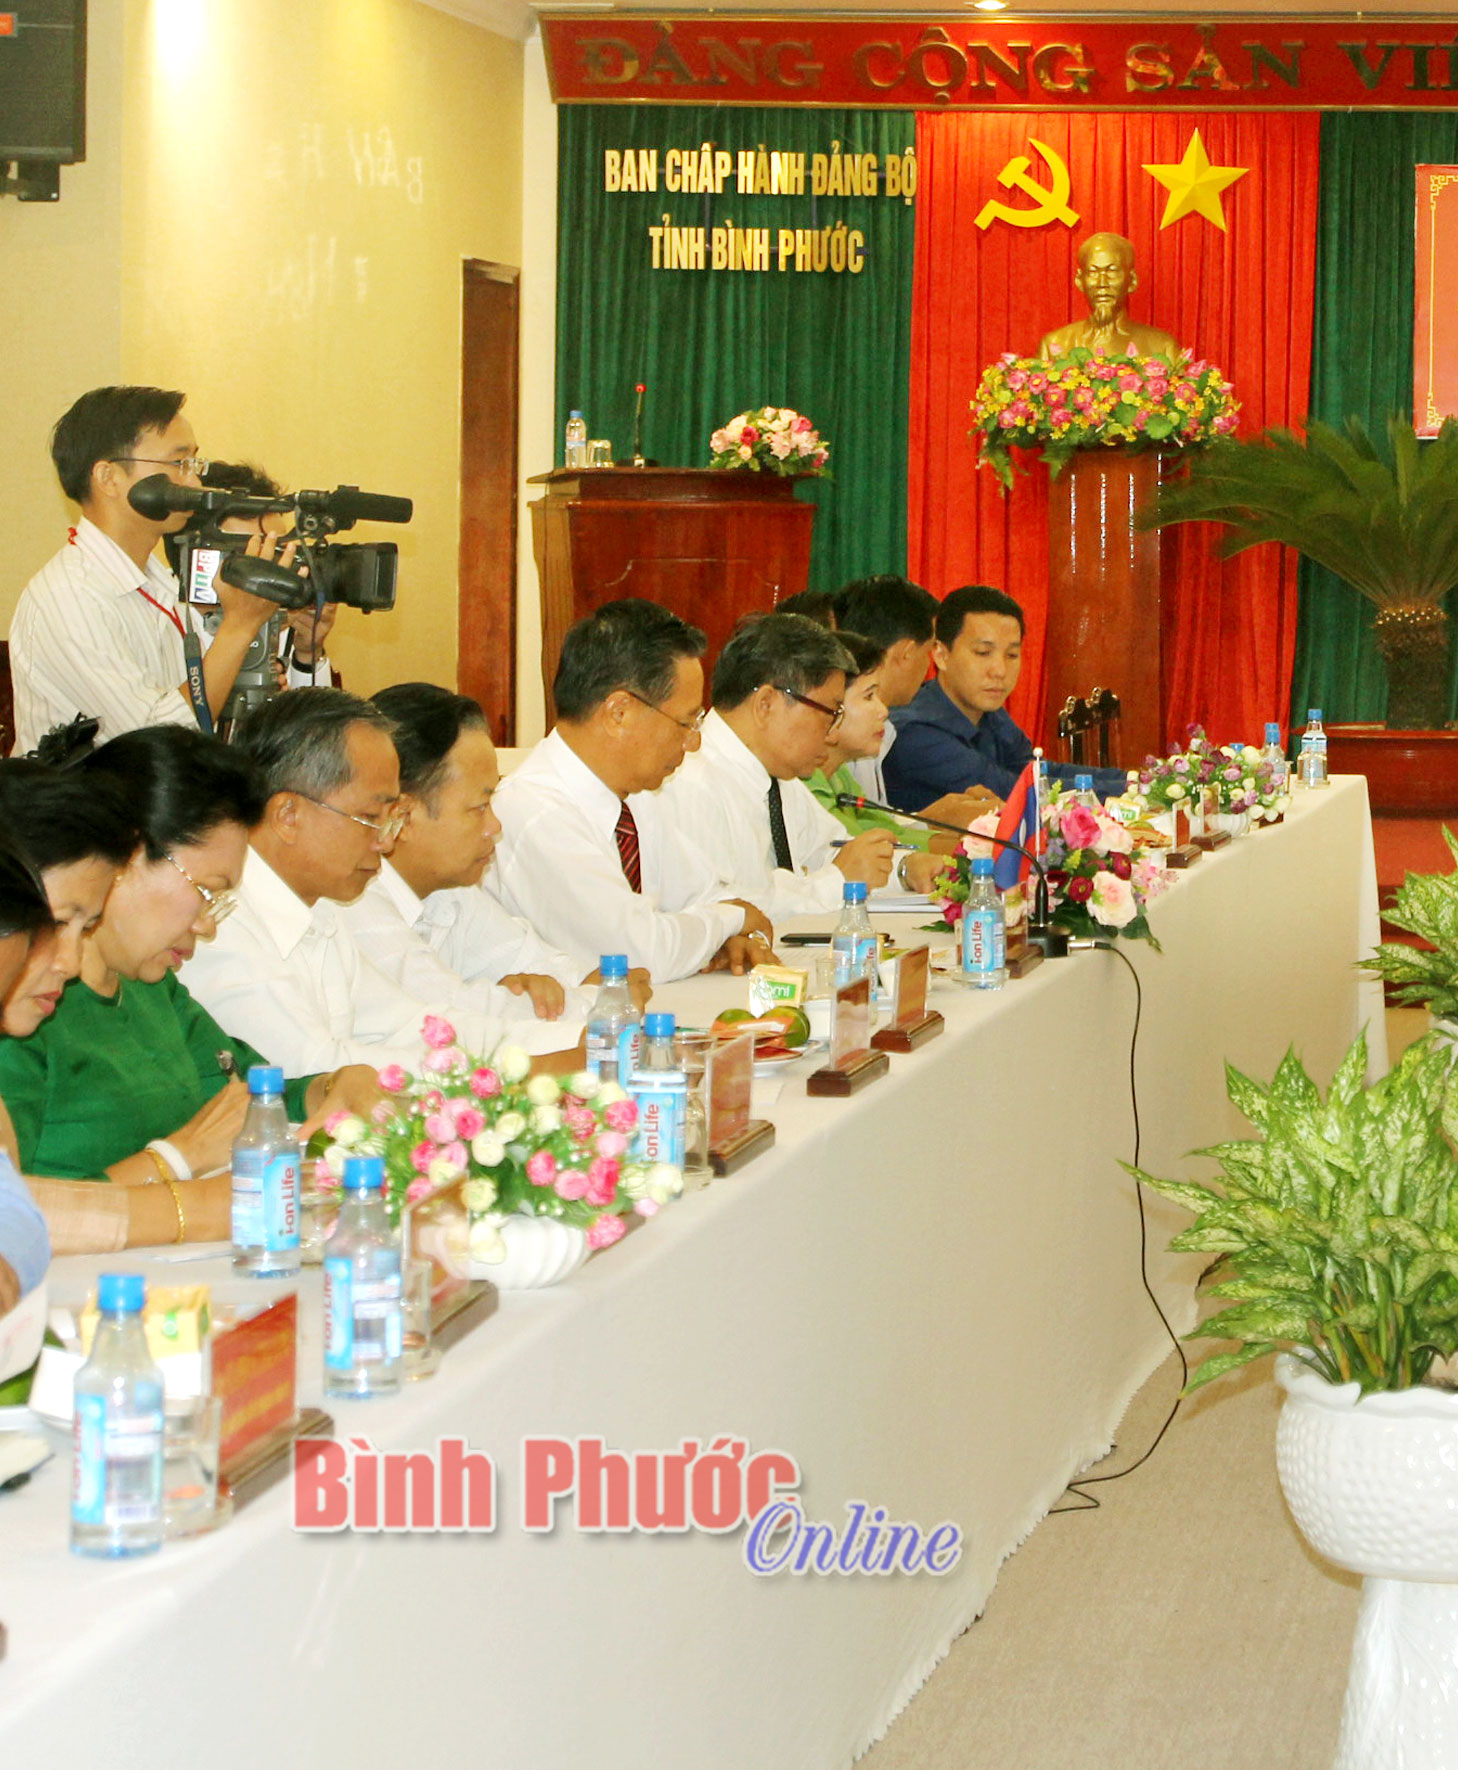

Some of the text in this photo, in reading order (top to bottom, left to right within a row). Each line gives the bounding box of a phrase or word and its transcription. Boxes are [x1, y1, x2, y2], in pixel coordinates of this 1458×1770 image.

[575, 20, 824, 90] ĐẢNG
[852, 28, 1096, 106] CỘNG
[1126, 26, 1304, 92] SẢN
[604, 140, 918, 206] BAN CHẤP HÀNH ĐẢNG BỘ
[648, 214, 865, 274] TỈNH BÌNH PHƯỚC
[190, 666, 205, 706] SONY
[972, 920, 982, 941] Life
[644, 1104, 659, 1132] Life
[281, 1167, 295, 1199] Life
